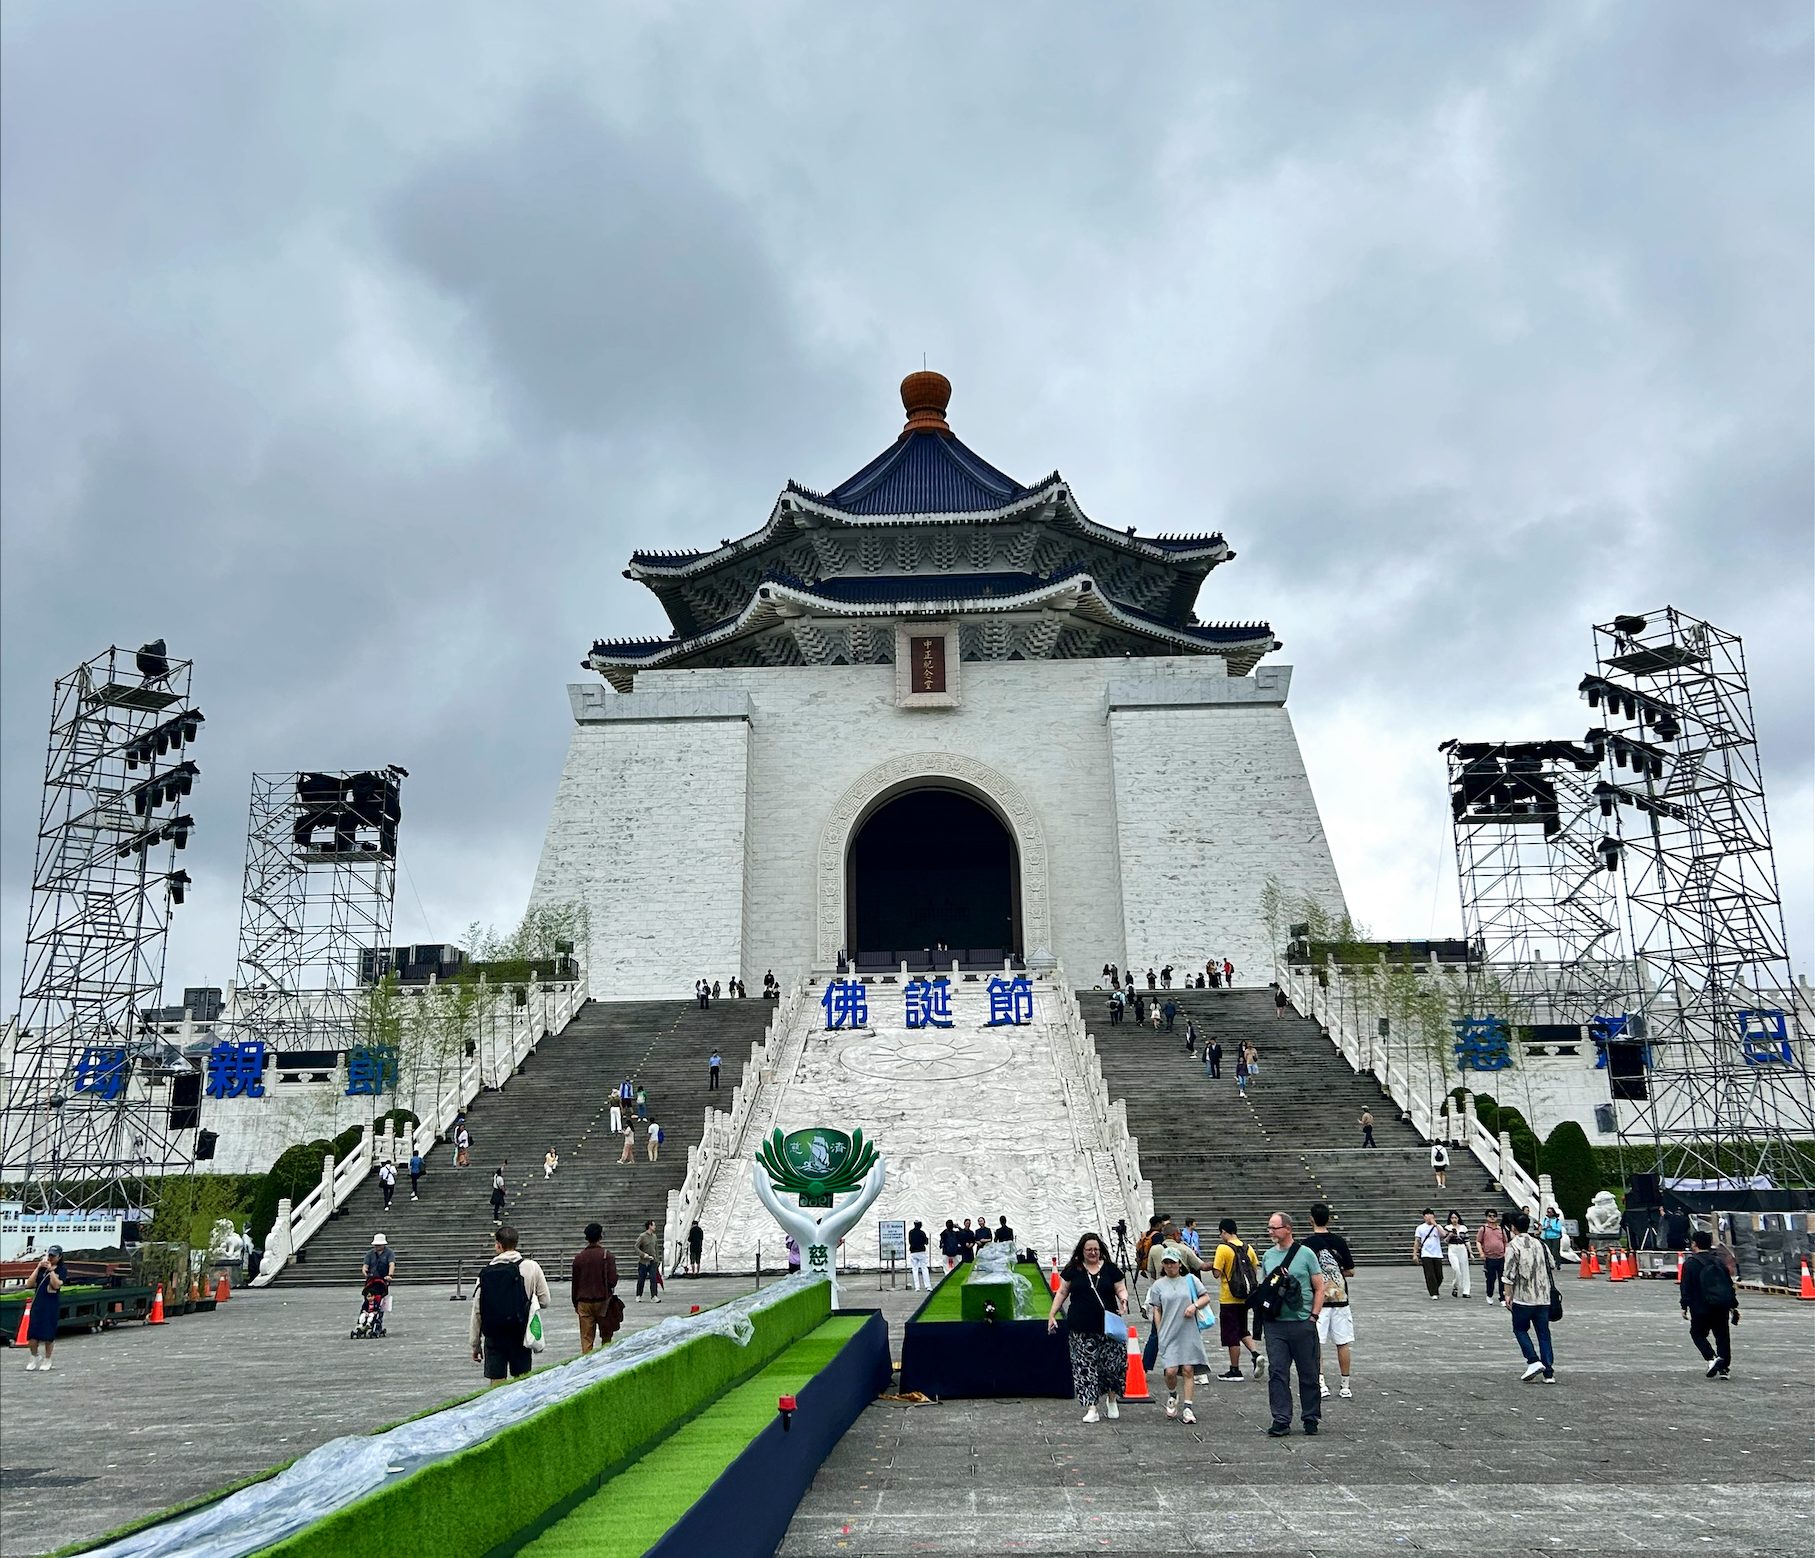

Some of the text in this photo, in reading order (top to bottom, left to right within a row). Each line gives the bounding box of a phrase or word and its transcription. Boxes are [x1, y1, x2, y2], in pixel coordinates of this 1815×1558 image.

[922, 639, 935, 690] 中正紀念堂
[821, 977, 1034, 1029] 佛誕節
[73, 1040, 398, 1101] 母親節
[808, 1244, 828, 1272] 慈
